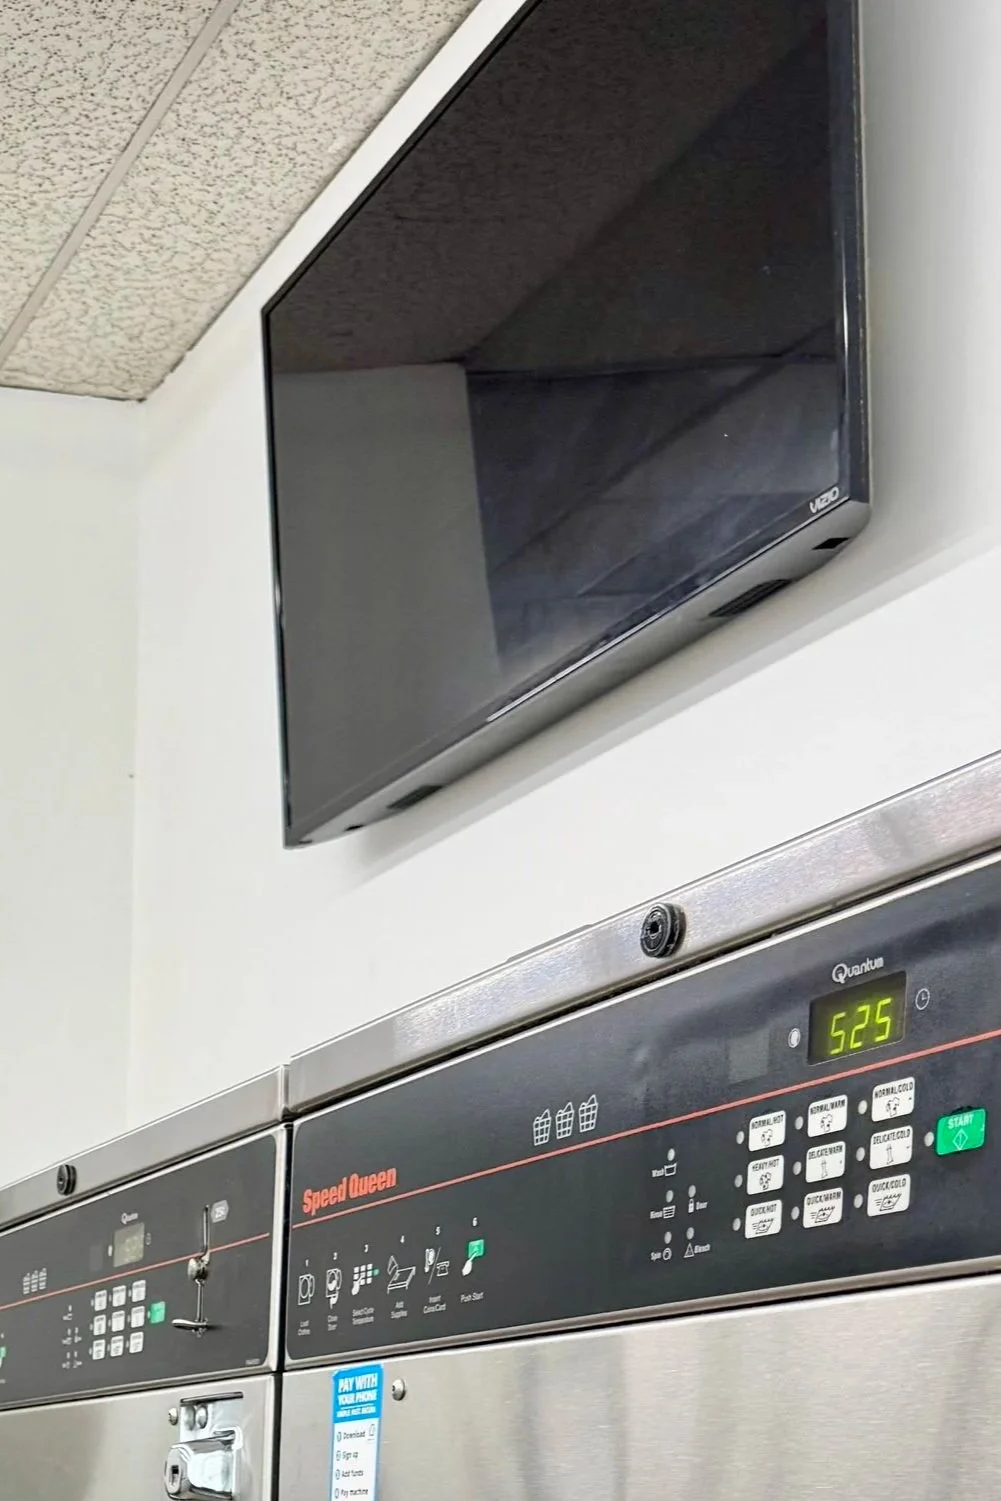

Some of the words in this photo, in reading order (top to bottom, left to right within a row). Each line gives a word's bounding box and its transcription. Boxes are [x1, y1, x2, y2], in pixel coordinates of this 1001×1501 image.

[809, 486, 840, 514] VIZIO
[832, 956, 884, 983] Quantum
[830, 997, 892, 1055] 525
[948, 1112, 974, 1130] START
[303, 1177, 347, 1216] Speed
[349, 1168, 397, 1198] Queen
[338, 1377, 354, 1393] PAY
[355, 1372, 378, 1391] WITH
